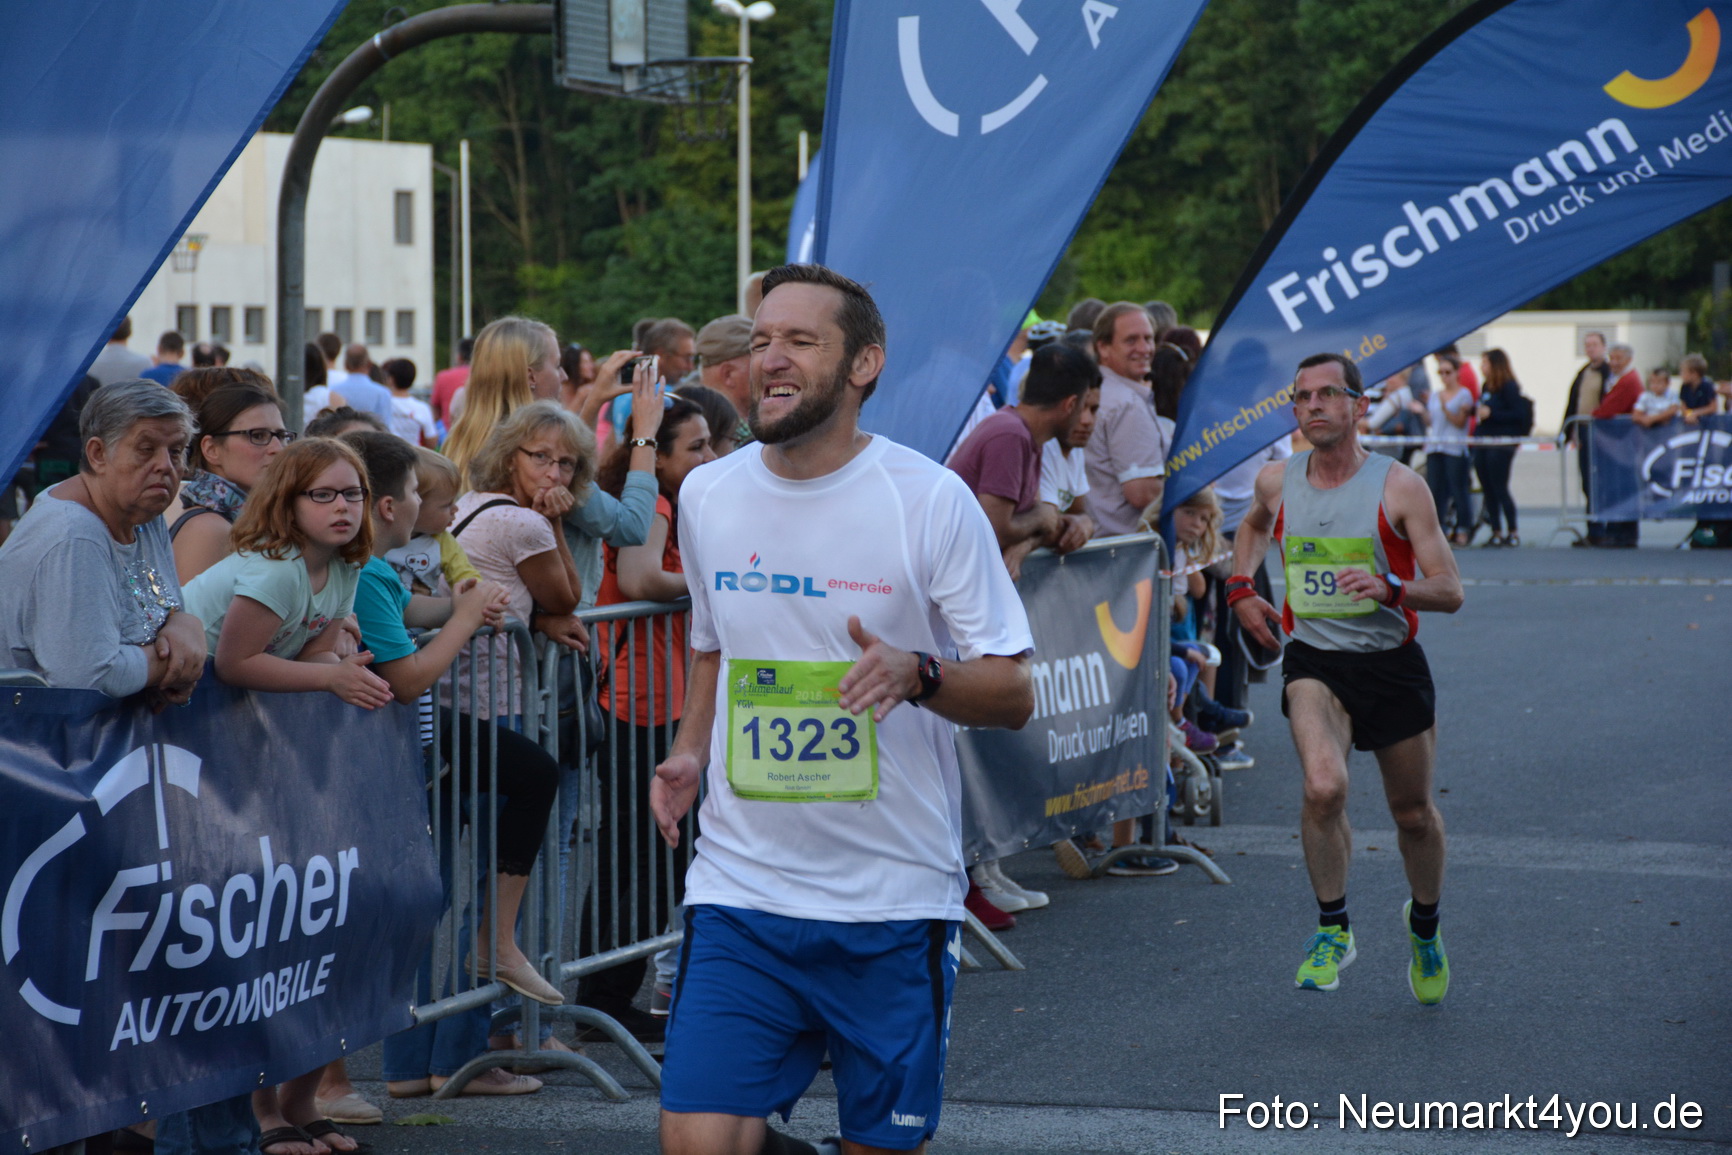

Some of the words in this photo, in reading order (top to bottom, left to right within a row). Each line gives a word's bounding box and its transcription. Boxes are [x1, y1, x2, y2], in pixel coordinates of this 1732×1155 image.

[1503, 187, 1595, 245] Druck
[1598, 157, 1658, 195] und
[1659, 109, 1732, 169] Medi
[1267, 117, 1639, 333] Frischmann
[1682, 489, 1732, 504] AUTO
[1304, 571, 1338, 596] 59
[742, 716, 861, 761] 1323
[1048, 721, 1087, 764] Druck
[1088, 714, 1112, 754] und
[767, 772, 795, 781] Robert
[797, 772, 831, 781] Ascher
[85, 836, 359, 982] Fischer
[109, 953, 335, 1051] AUTOMOBILE
